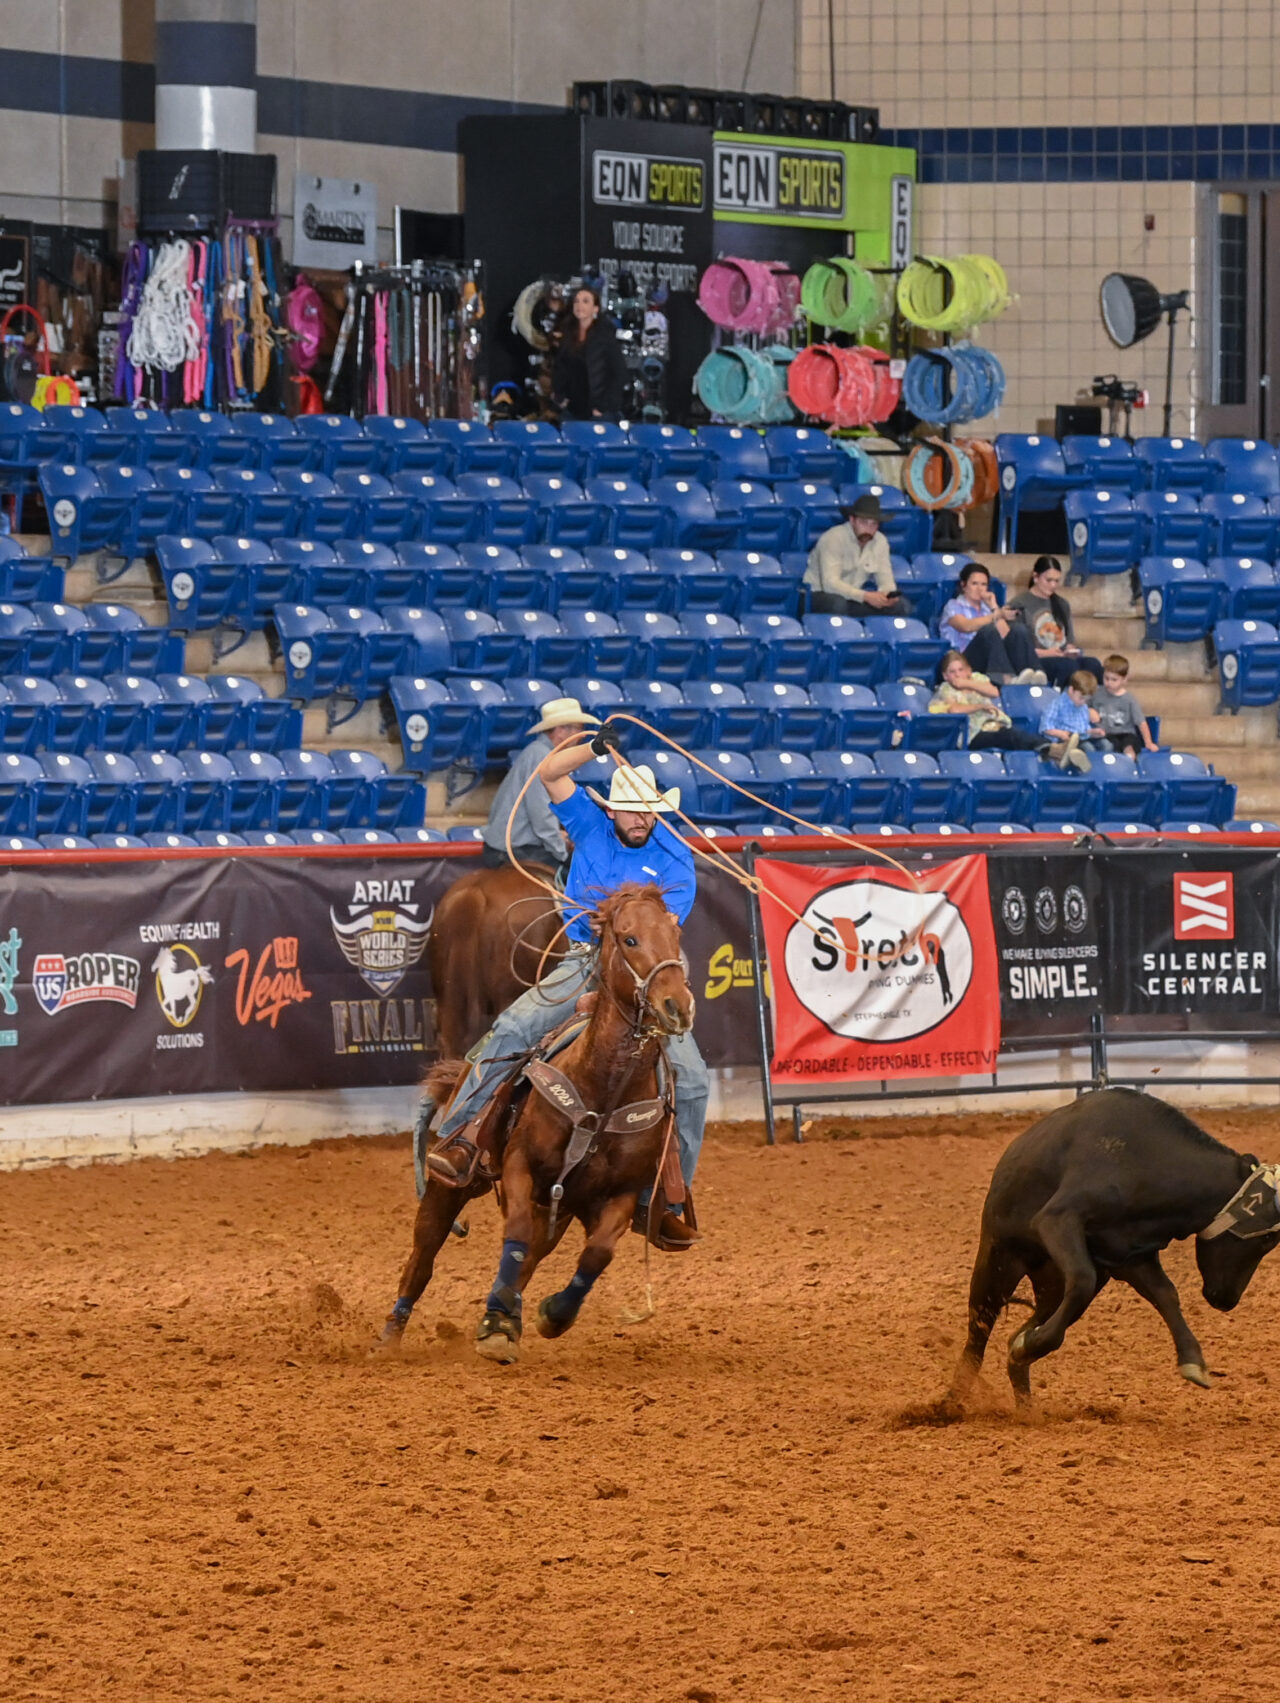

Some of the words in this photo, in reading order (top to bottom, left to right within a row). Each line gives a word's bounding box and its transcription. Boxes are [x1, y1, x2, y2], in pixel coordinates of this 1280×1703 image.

[600, 160, 642, 202] EQN
[650, 164, 701, 204] SPORTS
[720, 153, 769, 205] EQN
[780, 157, 841, 208] SPORTS
[613, 221, 640, 250] YOUR
[642, 223, 684, 254] SOURCE
[352, 880, 415, 903] ARIAT
[139, 924, 182, 943] EQUINE
[180, 921, 220, 941] HEALTH
[360, 932, 407, 950] WORLD
[363, 950, 405, 968] SERIES
[1143, 952, 1266, 971] SILENCER
[38, 978, 61, 1000] US
[65, 955, 137, 992] ROPER
[1009, 964, 1098, 999] SIMPLE.
[1148, 976, 1262, 995] CENTRAL
[156, 1032, 204, 1049] SOLUTIONS
[857, 1054, 931, 1072] DEPENDABLE
[549, 1084, 575, 1107] 2023
